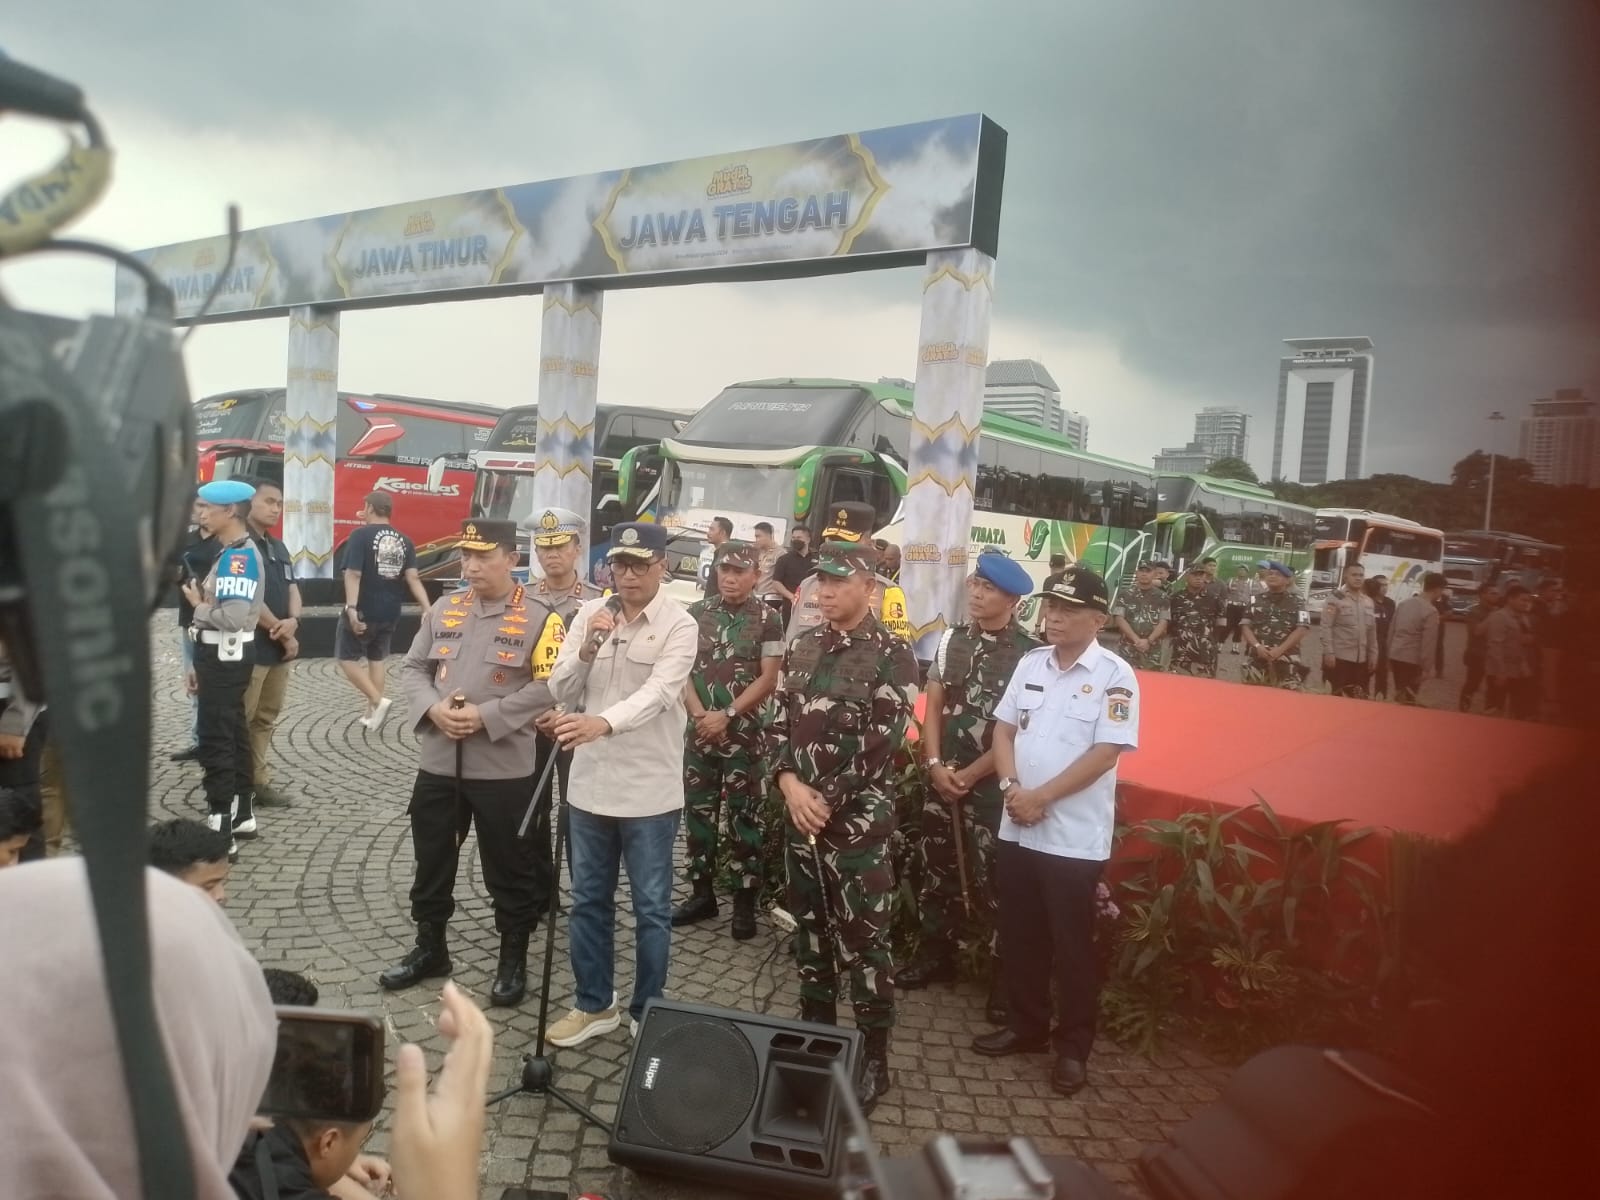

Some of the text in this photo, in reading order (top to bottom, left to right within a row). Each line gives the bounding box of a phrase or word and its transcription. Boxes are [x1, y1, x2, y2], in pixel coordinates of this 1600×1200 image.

[620, 190, 849, 248] JAWA TENGAH
[355, 234, 489, 279] JAWA TIMUR
[165, 270, 200, 299] AWA
[215, 576, 258, 600] PROV
[494, 635, 524, 648] POLRI
